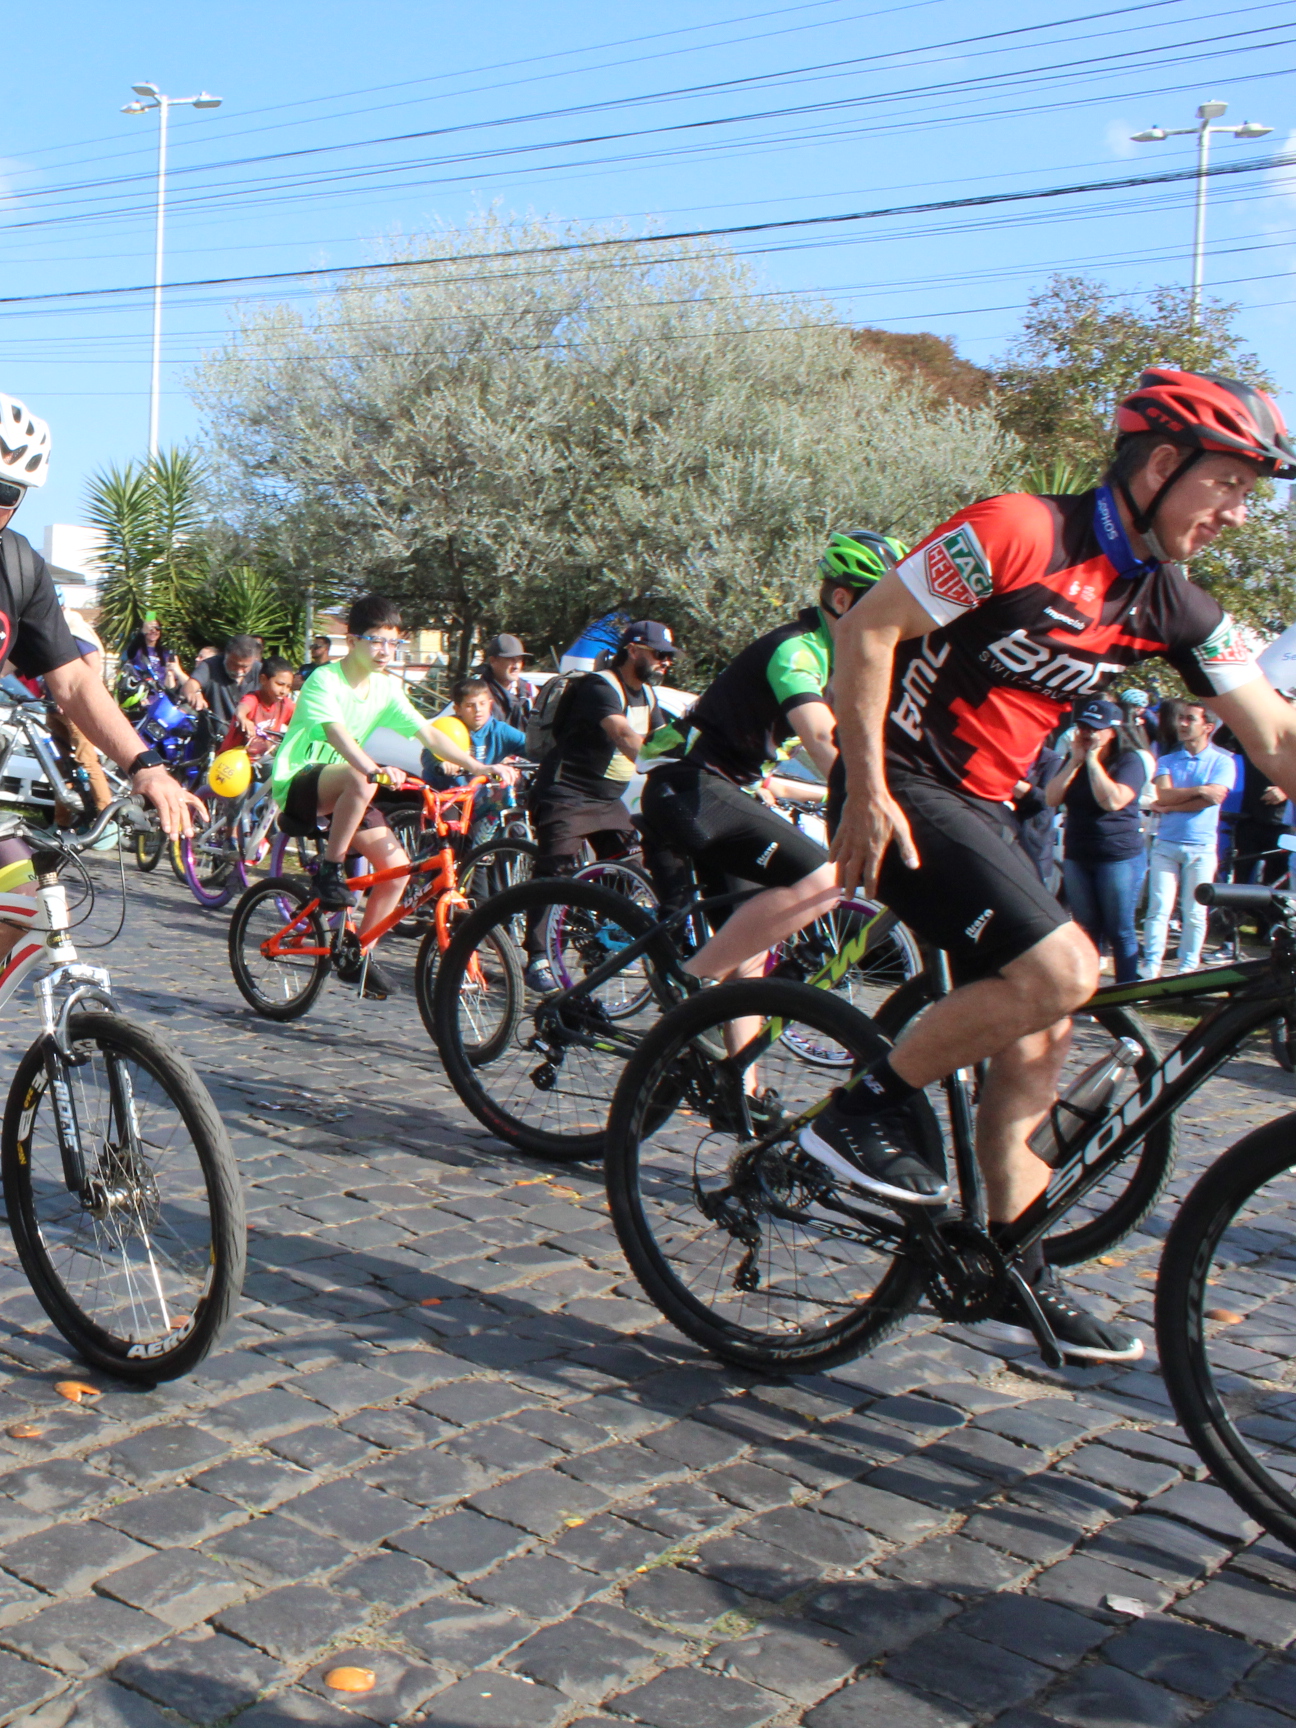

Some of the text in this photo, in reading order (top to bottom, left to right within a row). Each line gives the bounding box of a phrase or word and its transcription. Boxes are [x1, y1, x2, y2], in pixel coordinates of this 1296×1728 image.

[949, 536, 989, 592] TAG
[891, 633, 951, 741] BMC
[987, 628, 1127, 695] BMC
[1046, 1046, 1204, 1210] SOUL
[127, 1307, 197, 1359] AERO
[771, 1336, 842, 1359] MEZCAL
